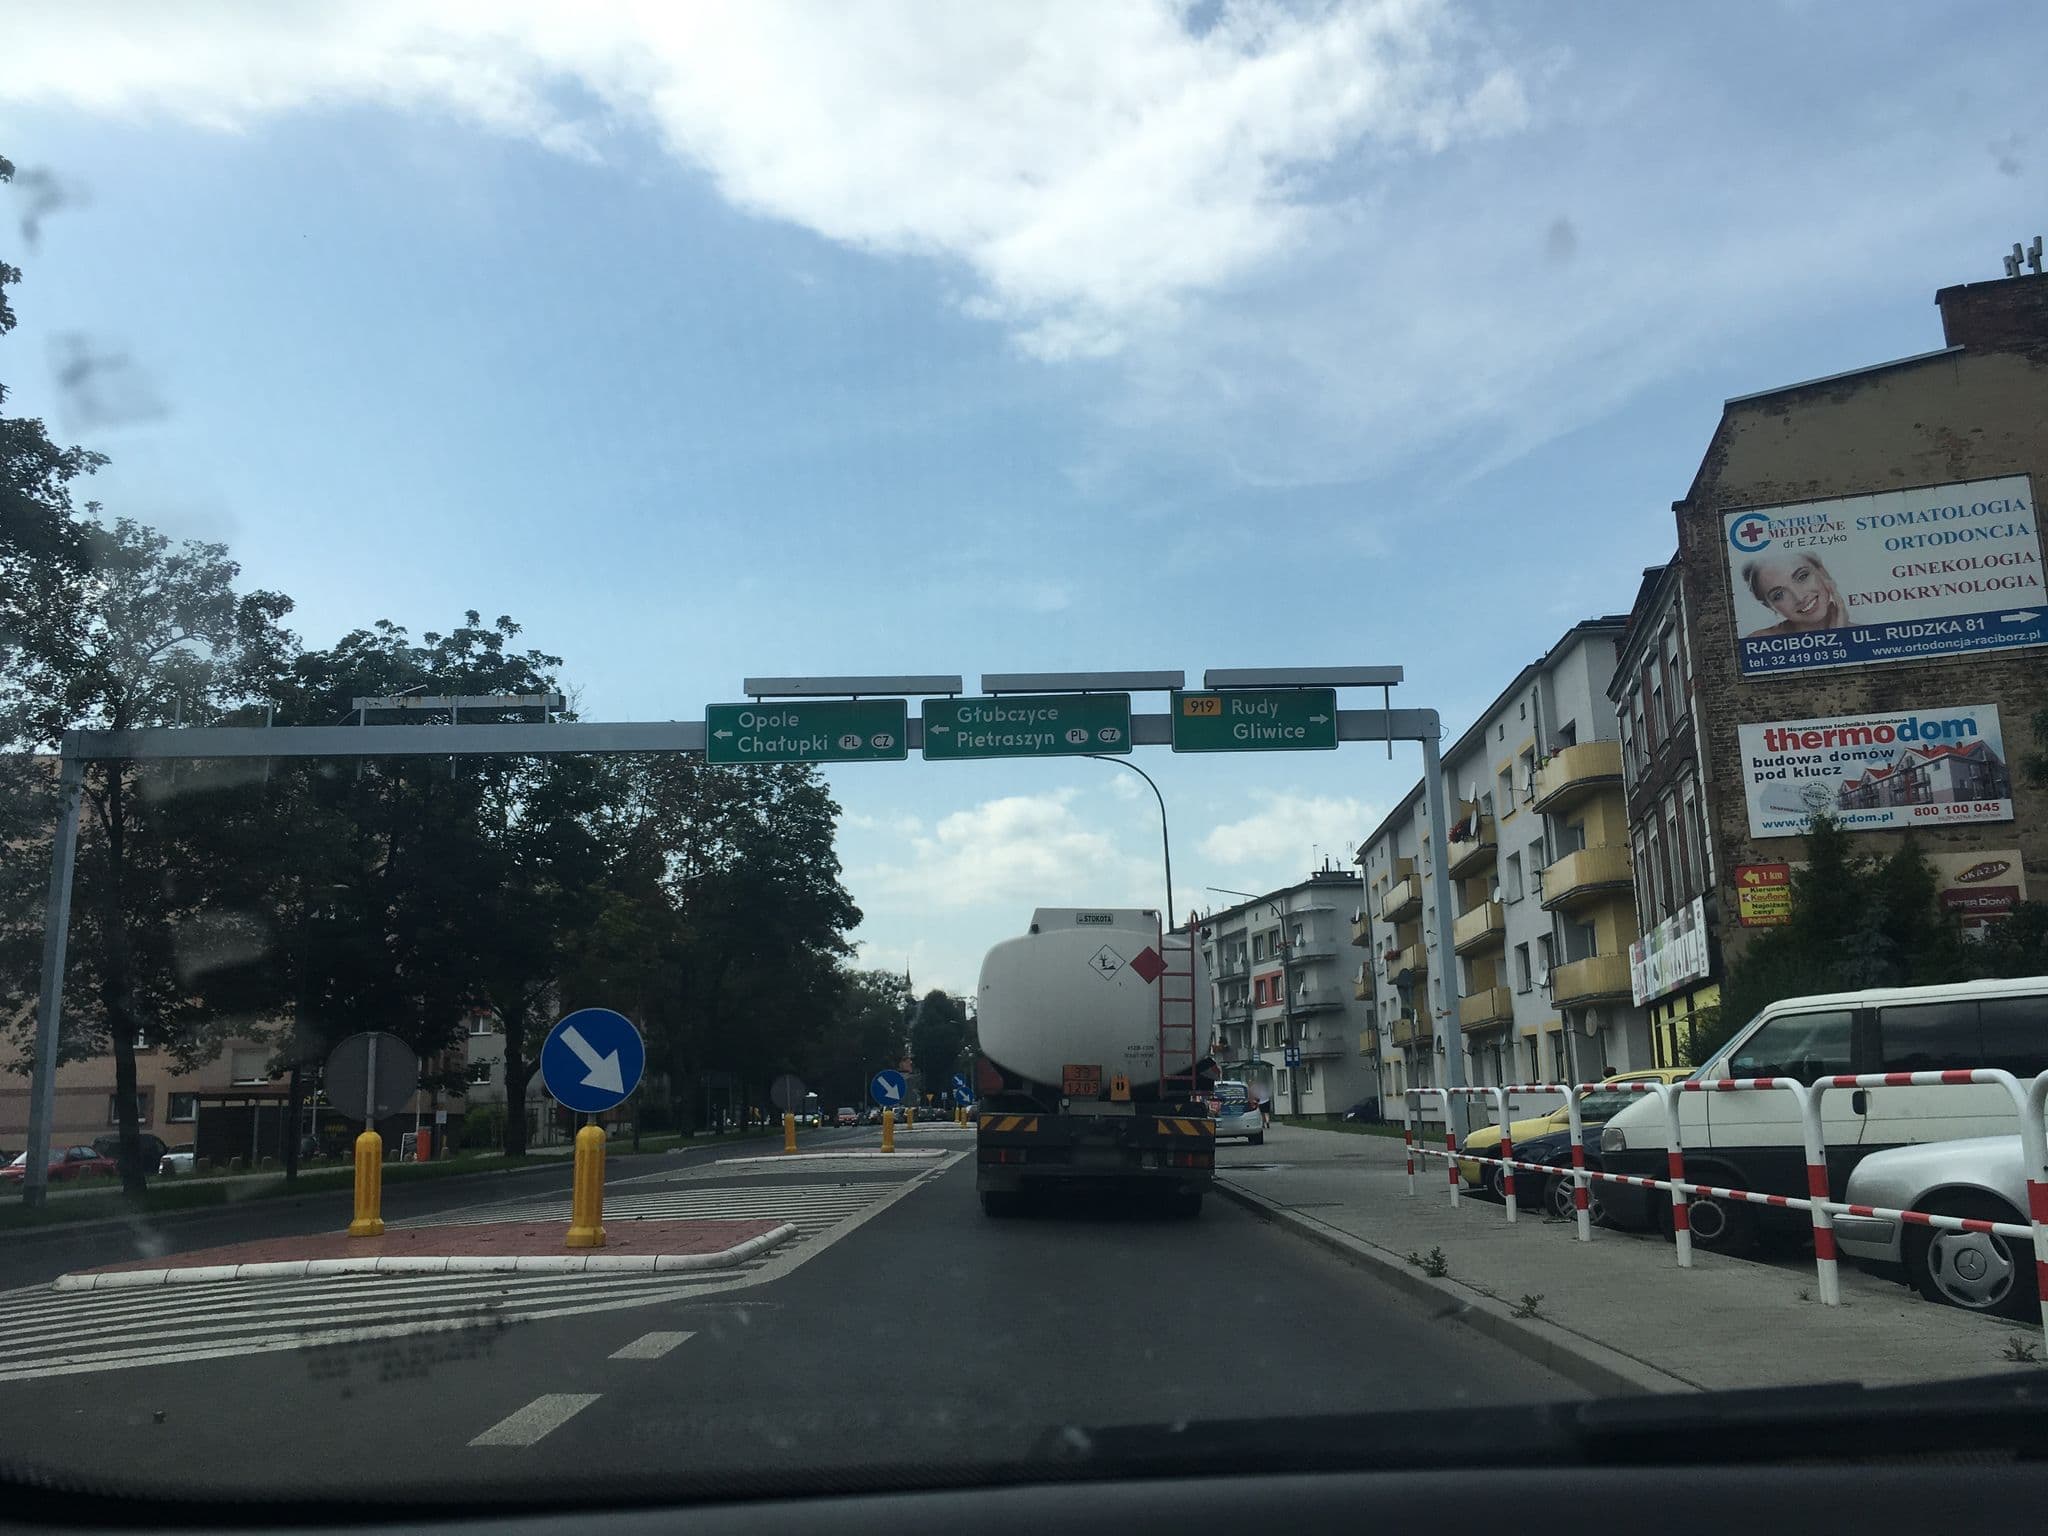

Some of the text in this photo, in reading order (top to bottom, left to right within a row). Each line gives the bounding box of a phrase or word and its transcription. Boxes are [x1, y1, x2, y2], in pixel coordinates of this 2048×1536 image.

[1856, 498, 2026, 531] STOMATOLOGIA
[1768, 521, 1846, 539] MEDYCZNE
[1884, 523, 2030, 551] ORTODONCJA
[1892, 551, 2036, 578] GINEKOLOGIA
[1848, 574, 2039, 607] ENDOKRYNOLOGIA
[1746, 618, 1985, 655] RACIBÓRZ, UL. RUDZKA 81
[1872, 629, 2041, 656] www.ortodoncja-raciborz.pl
[1749, 648, 1847, 668] tel. 32 419 03 50
[957, 706, 1059, 725] Głubczyce
[1190, 699, 1278, 718] 919 Rudy
[738, 711, 800, 732] Opole
[1233, 723, 1306, 740] Gliwice
[737, 734, 890, 755] Chałupki PL CZ
[957, 731, 1055, 749] Pietraszyn
[1099, 729, 1116, 741] CZ
[1753, 748, 1895, 768] budowa domów
[1754, 765, 1842, 783] pod klucz
[1914, 806, 1939, 817] 800
[1944, 804, 1969, 815] 100
[1974, 802, 2000, 813] 045
[1762, 811, 1894, 829] www.thodom.pl
[1769, 871, 1783, 880] km
